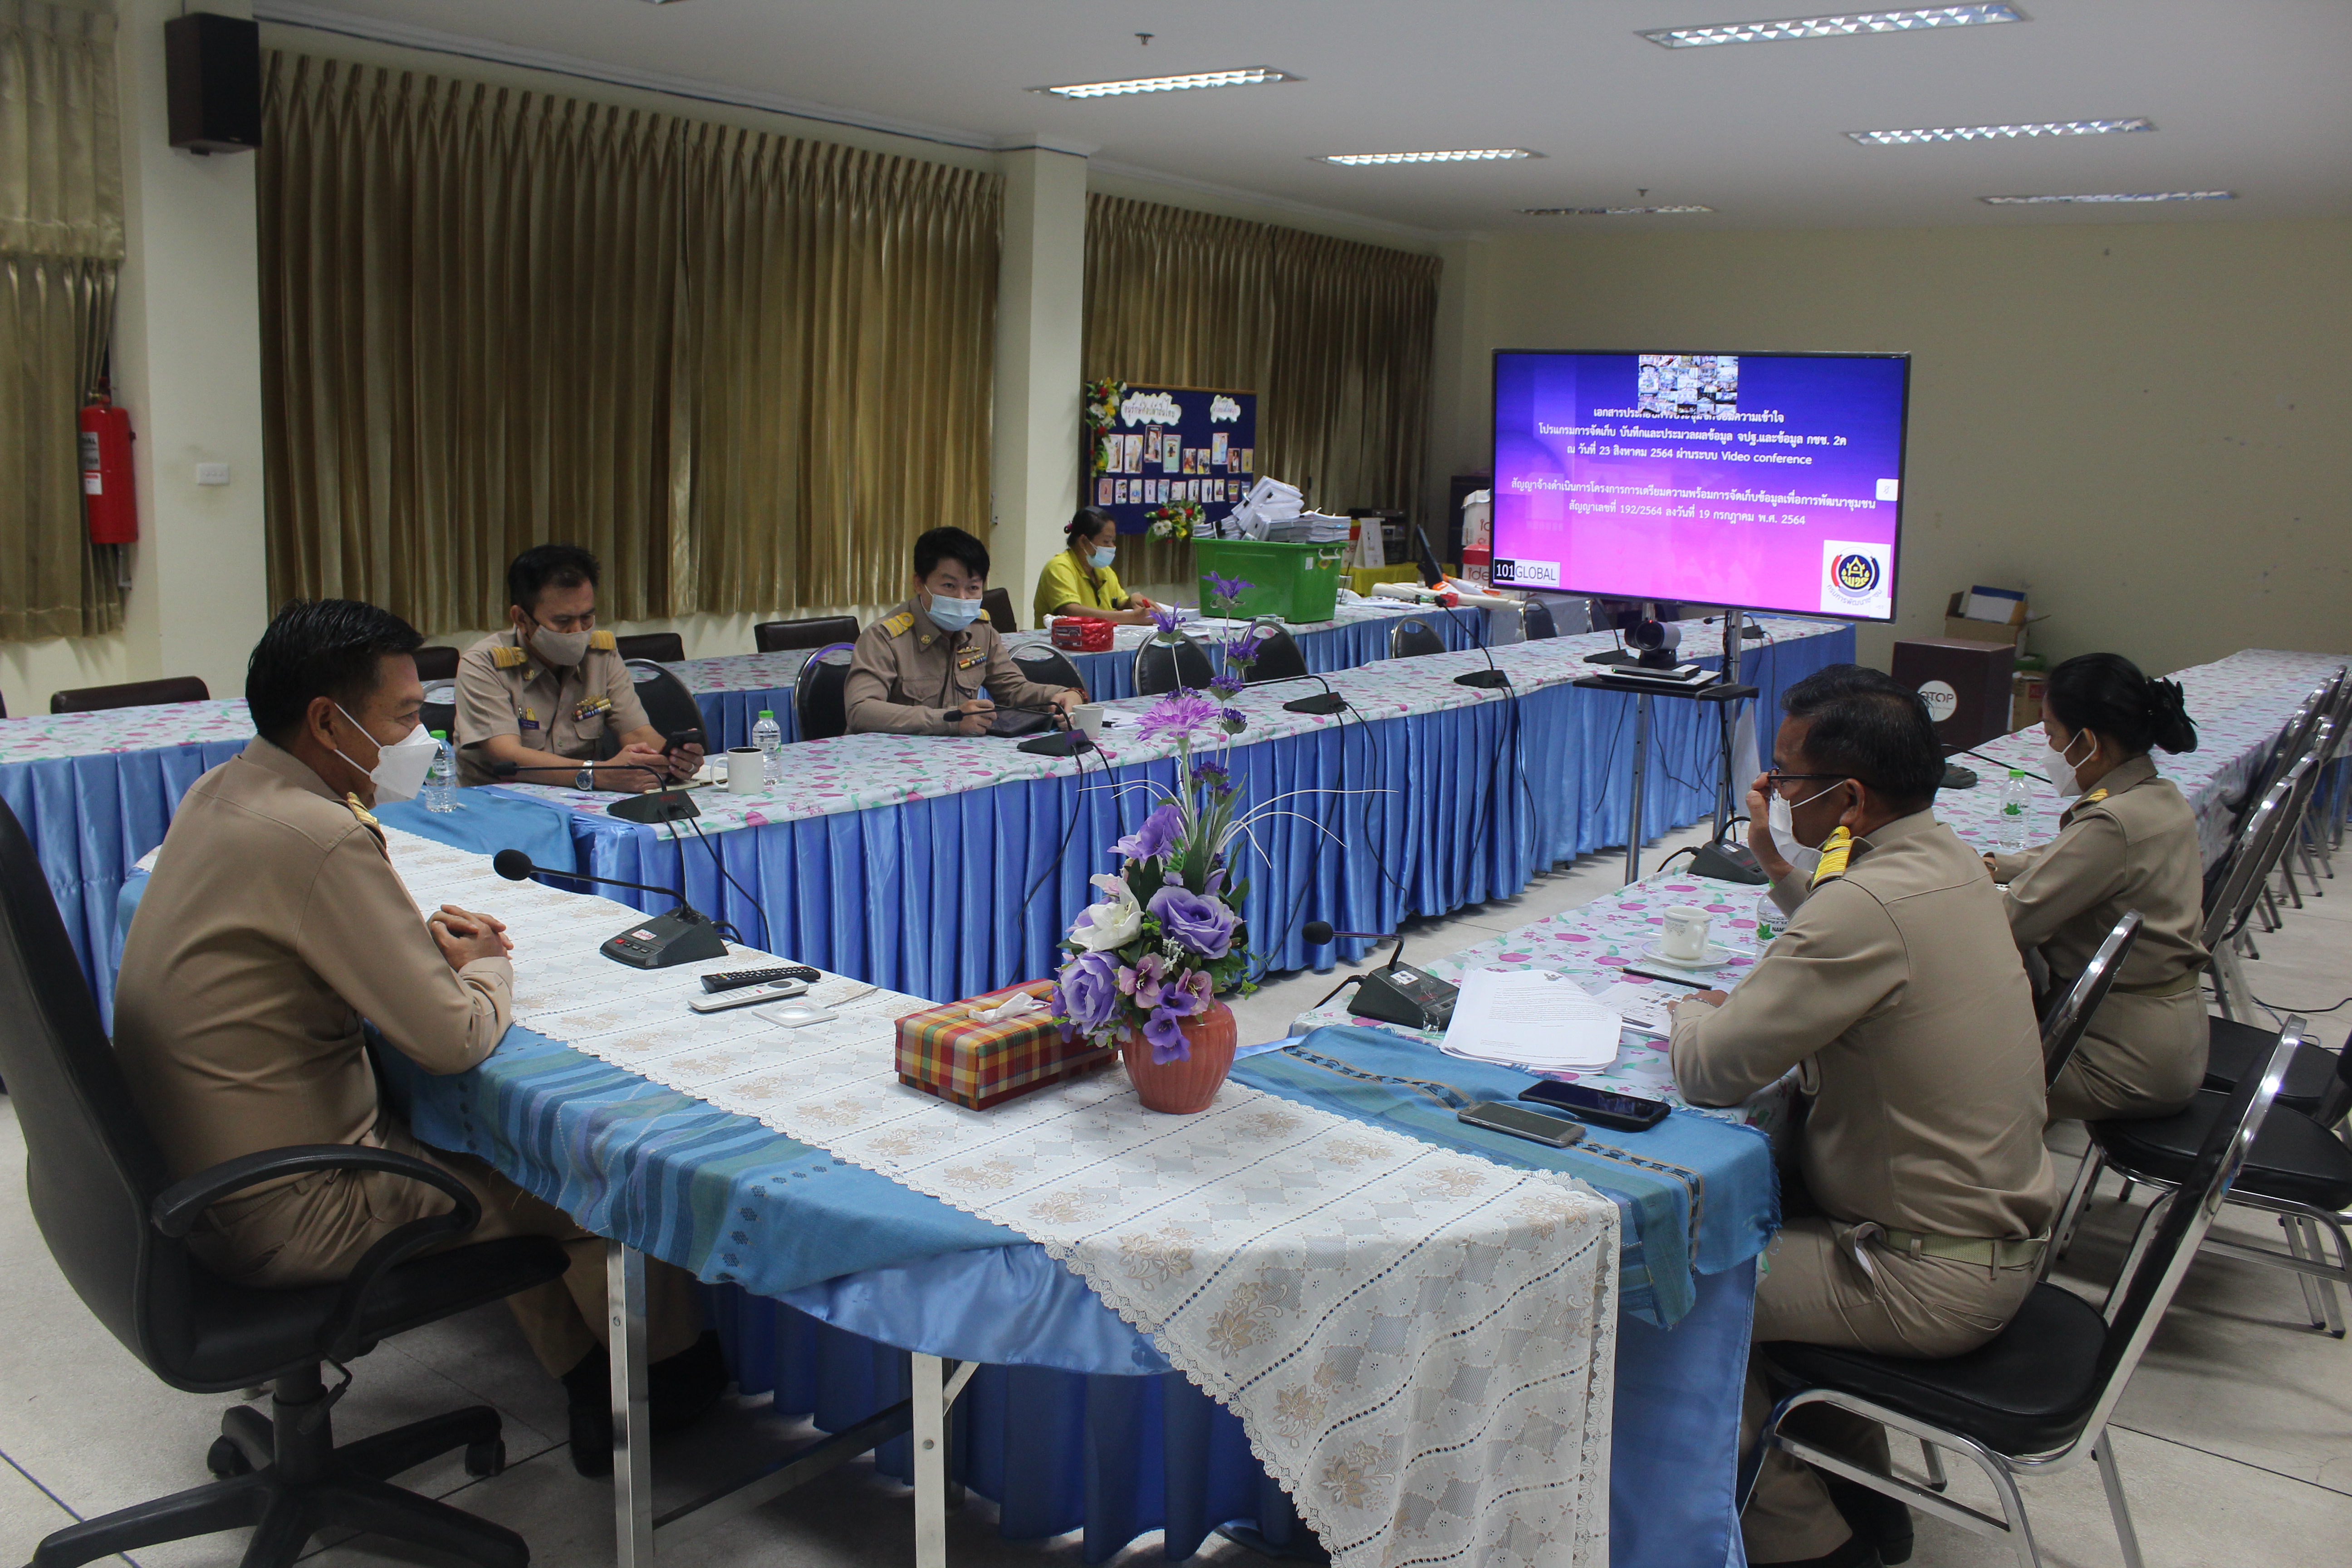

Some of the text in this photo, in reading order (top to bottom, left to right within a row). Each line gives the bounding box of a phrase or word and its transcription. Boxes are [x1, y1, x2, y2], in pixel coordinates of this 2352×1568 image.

[1539, 422, 1616, 437] โปรแกรมการจัดเก็บ
[1620, 425, 1733, 445] บันทึกและประมวลผลข้อมูล
[1737, 430, 1803, 448] จปฐ.และข้อมูล
[1567, 441, 1812, 465] ณ วันที่ 23 สิงหาคม 2564 ผ่านระบบ Video conference
[1569, 499, 1806, 525] สัญญาเลขที่ 192/2564 ลงวันที่ 19 กรกฎาคม พ.ศ. 2564
[1468, 567, 1490, 581] ide
[1496, 564, 1556, 581] 101 GLOBAL
[1827, 584, 1882, 606] กรมการพัฒนาชชน
